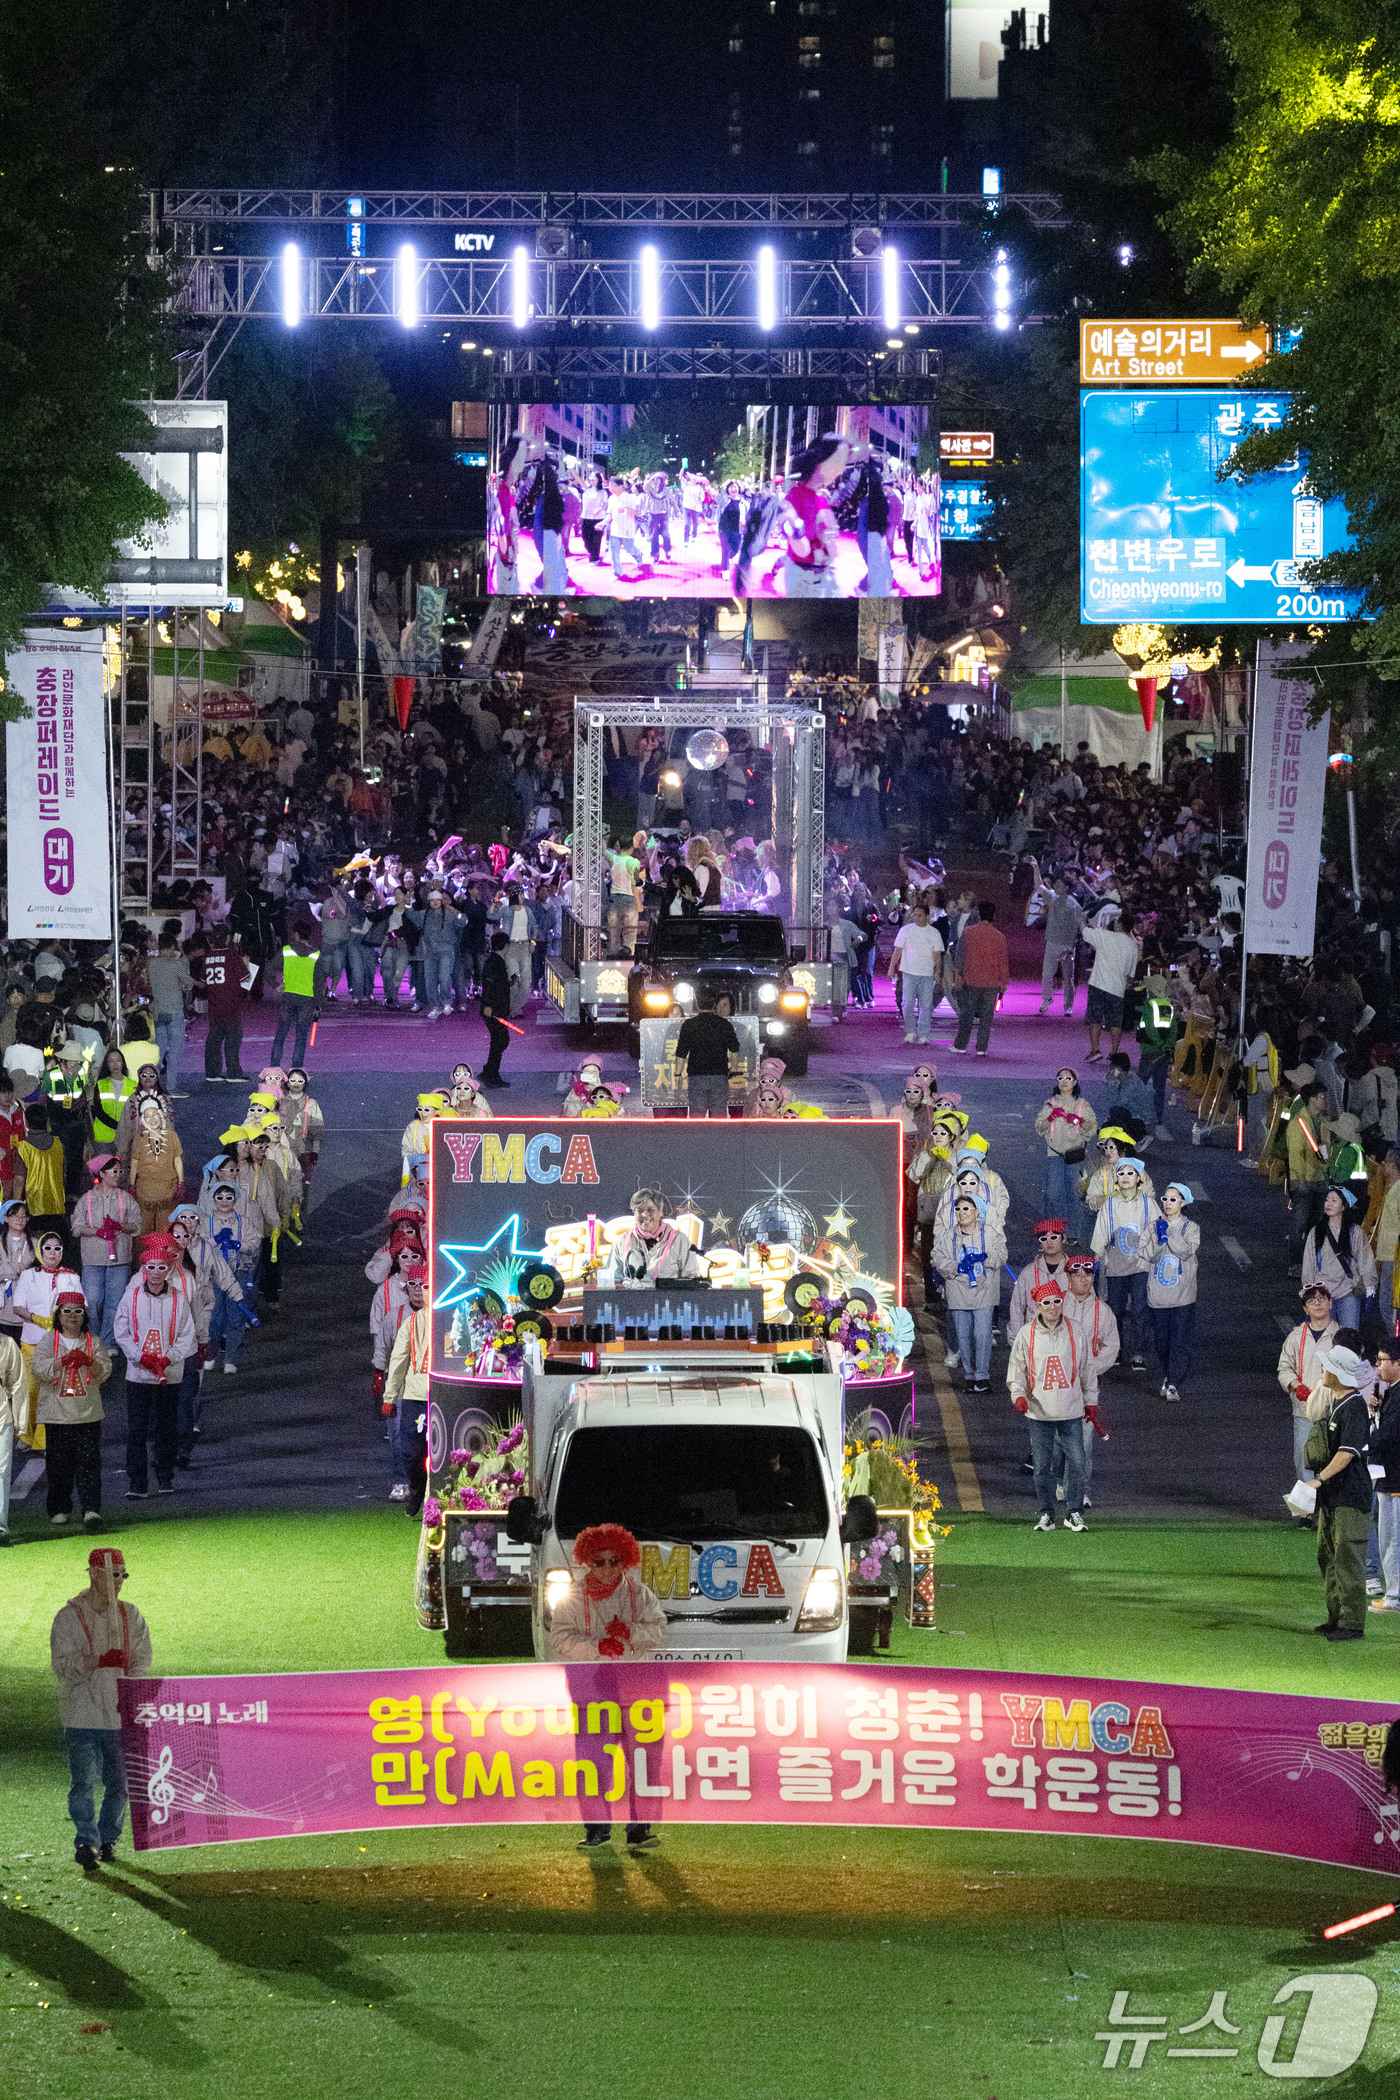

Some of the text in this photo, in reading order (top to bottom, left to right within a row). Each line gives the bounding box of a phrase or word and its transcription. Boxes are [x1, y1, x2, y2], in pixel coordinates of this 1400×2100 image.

[455, 234, 495, 250] KCTV
[1090, 327, 1212, 357] 예술의거리
[1091, 358, 1184, 376] Art Street
[941, 524, 956, 538] ity
[1300, 504, 1318, 550] 금남로
[1088, 538, 1222, 573] 천변우로
[1088, 578, 1223, 601] Cheonbyeonu-ro
[1276, 594, 1345, 617] 200m
[36, 667, 60, 821] 충장퍼레이드
[62, 669, 75, 798] 라인문화재단과 함께하는
[47, 837, 69, 888] 대기
[205, 966, 226, 985] 23
[444, 1132, 600, 1185] YMCA
[1117, 1223, 1140, 1256] C
[1157, 1254, 1180, 1288] C
[1042, 1354, 1070, 1391] A
[133, 1700, 269, 1728] 추억의 노래
[844, 1685, 984, 1744] 청춘!
[1001, 1693, 1174, 1759] YMCA
[1318, 1722, 1389, 1749] 젊음의
[371, 1744, 1182, 1818] 만(Man)나면 즐거운 학운동!
